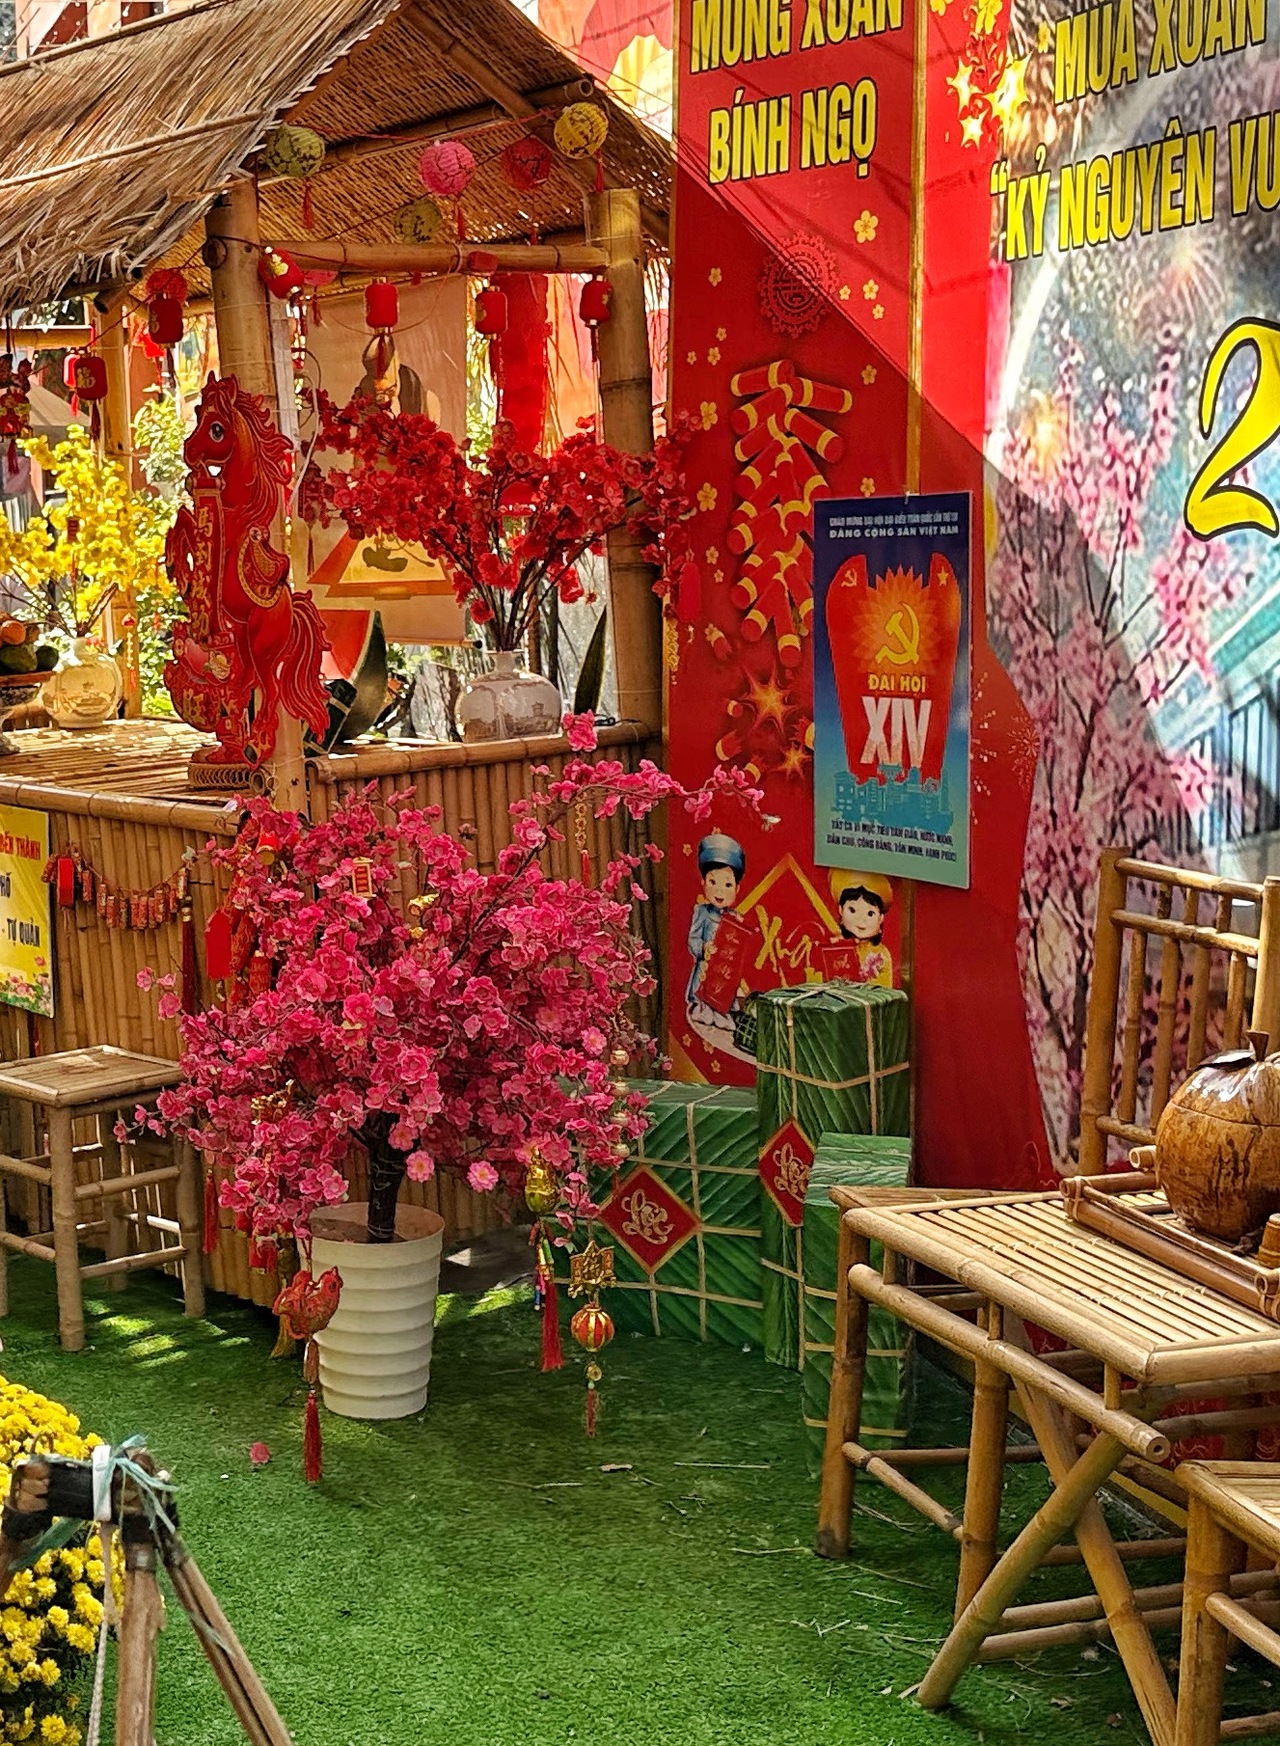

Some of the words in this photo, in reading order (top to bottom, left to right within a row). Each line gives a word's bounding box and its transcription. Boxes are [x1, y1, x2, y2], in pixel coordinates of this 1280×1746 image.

[709, 87, 791, 185] BÍNH
[800, 77, 878, 179] NGỌ
[1058, 115, 1217, 252] NGUYÊN
[1184, 317, 1280, 542] 2
[829, 527, 861, 538] ĐẢNG
[864, 527, 894, 539] CỘNG
[897, 526, 917, 536] SẢN
[919, 525, 938, 537] VIỆT
[940, 525, 959, 535] NAM
[868, 673, 895, 694] ĐẠI
[900, 672, 926, 696] HỘI
[860, 696, 932, 768] XIV
[0, 831, 14, 855] BẾN
[16, 835, 41, 861] THÀNH
[7, 918, 17, 946] TỰ
[19, 917, 40, 948] QUẢN
